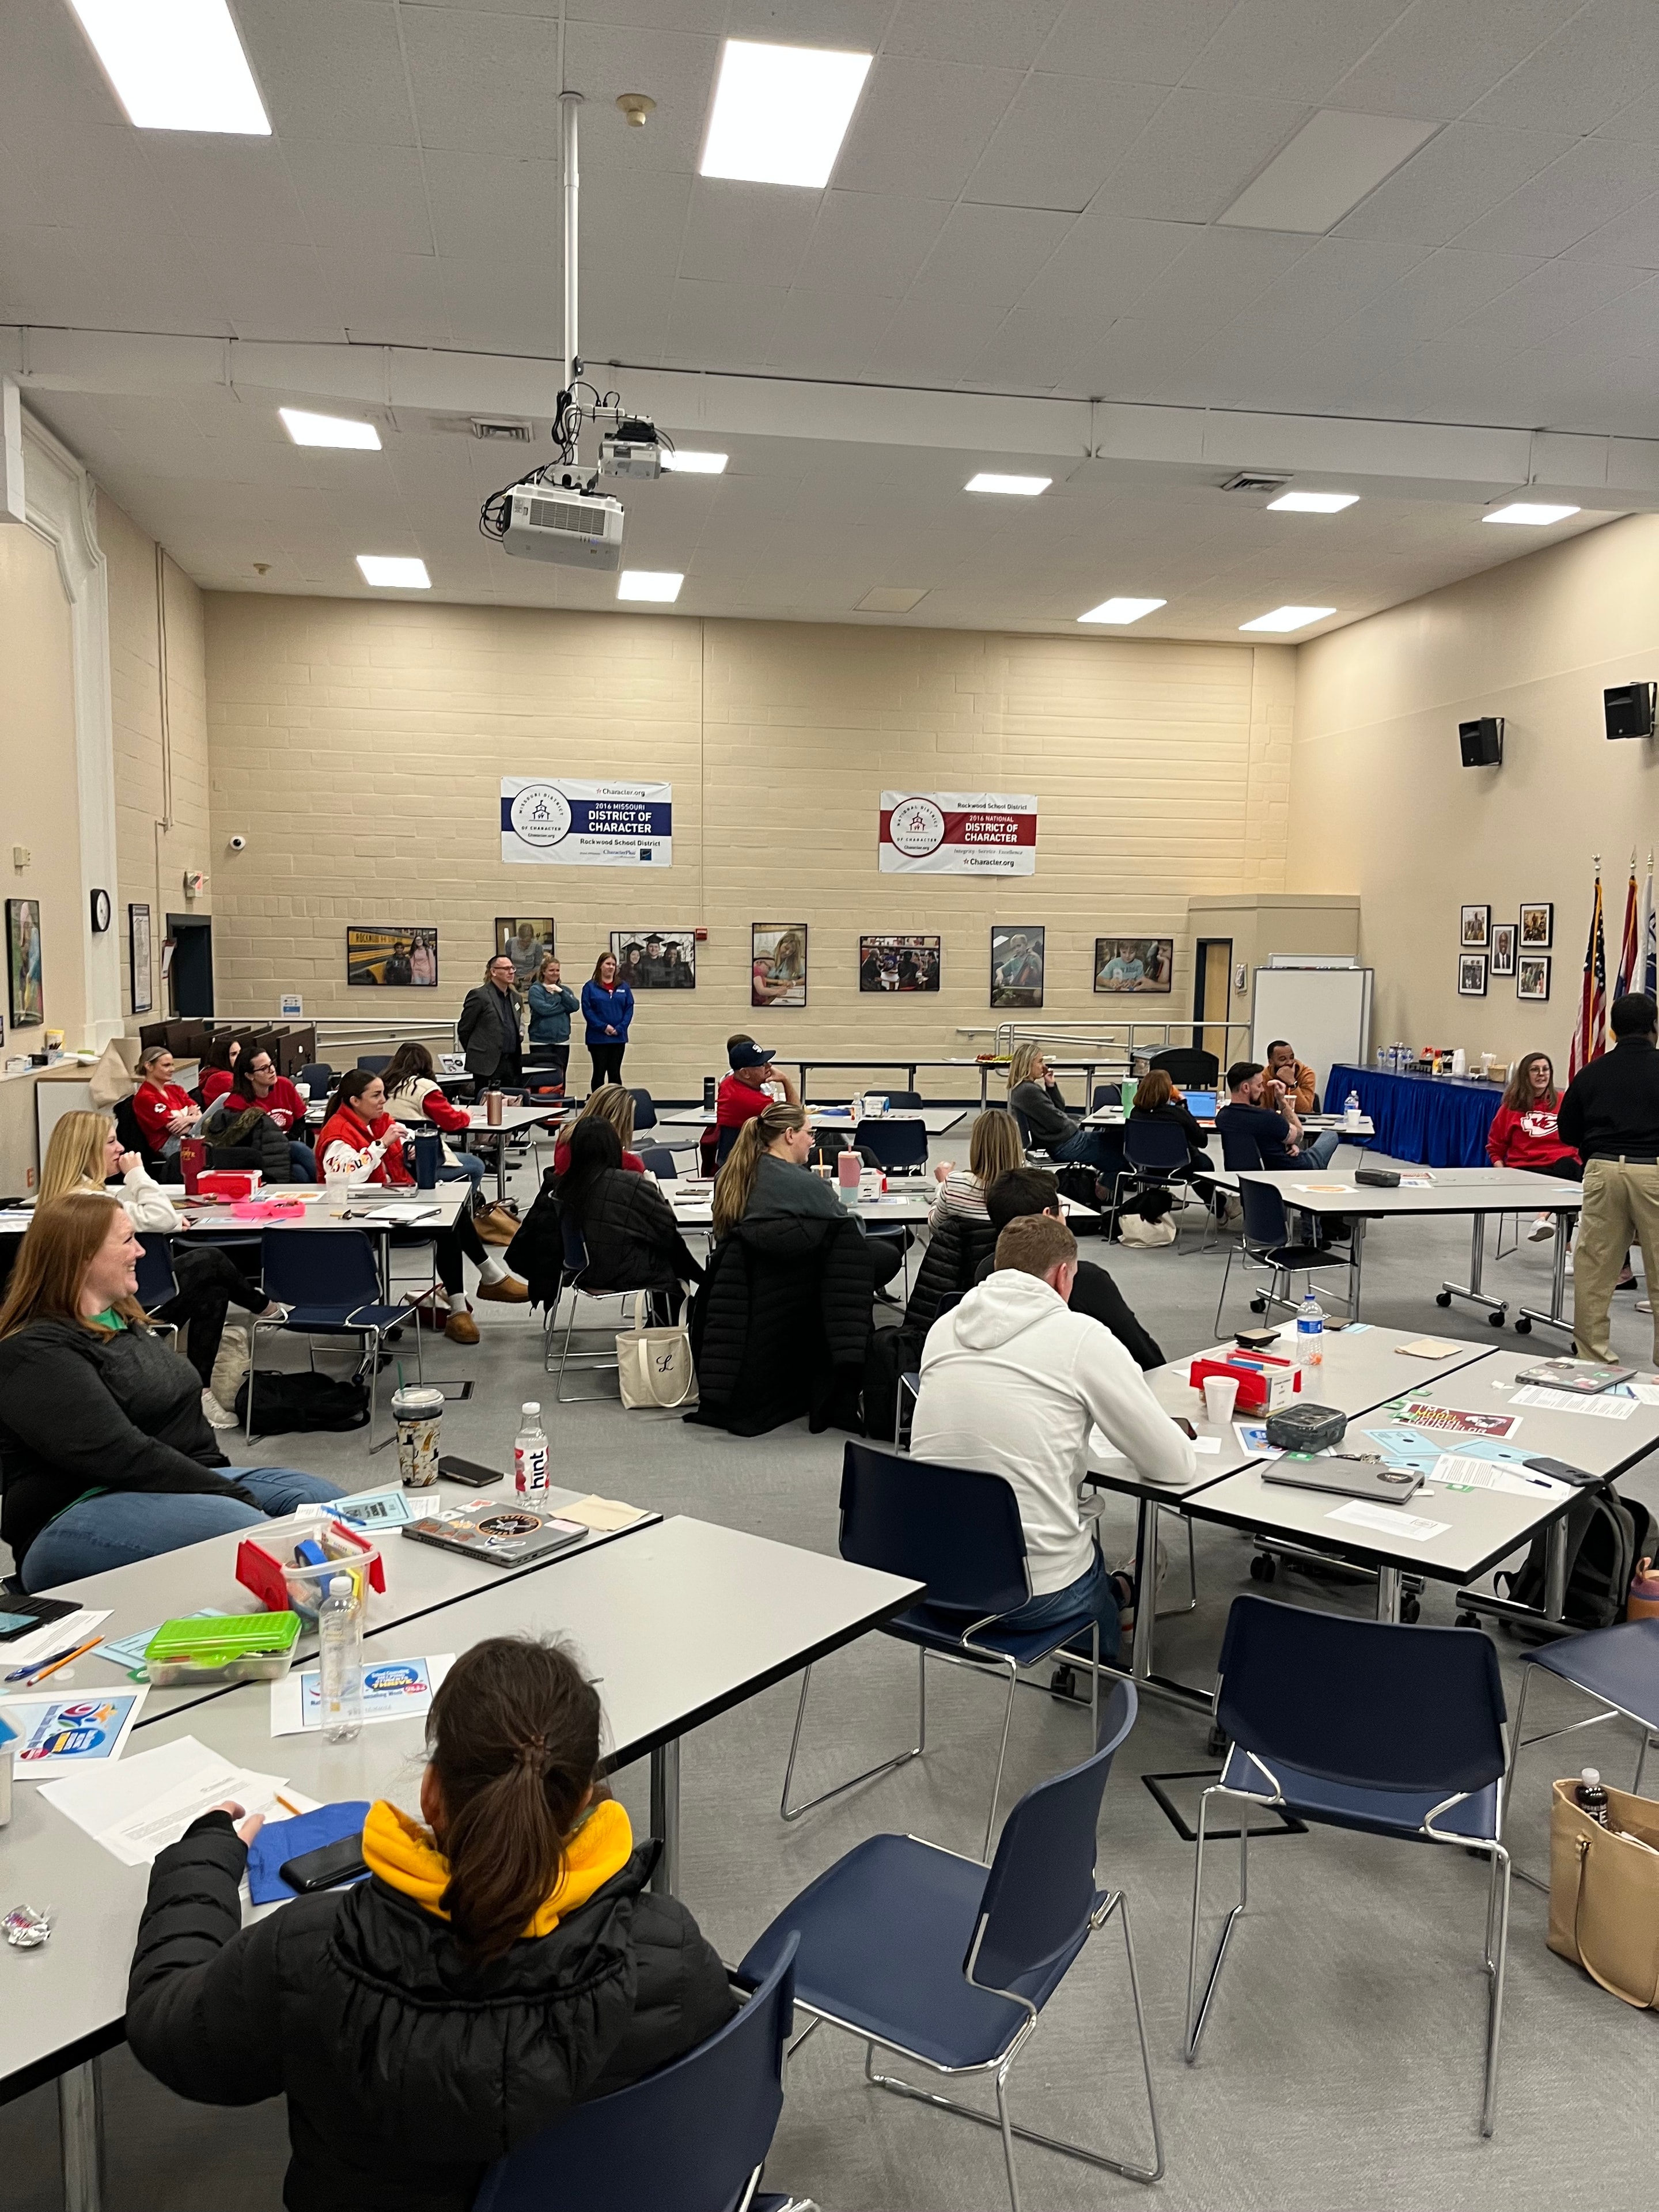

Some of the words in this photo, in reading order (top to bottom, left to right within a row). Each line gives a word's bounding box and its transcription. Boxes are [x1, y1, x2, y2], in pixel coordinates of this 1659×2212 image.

[603, 789, 645, 797] Character.org
[588, 810, 636, 821] DISTRICT
[638, 812, 652, 821] OF
[589, 822, 652, 833] CHARACTER
[965, 823, 1005, 832] DISTRICT
[1006, 824, 1018, 833] OF
[965, 832, 1018, 843] CHARACTER
[970, 858, 1014, 868] Character.org
[656, 1354, 675, 1373] L
[529, 1450, 544, 1490] hint
